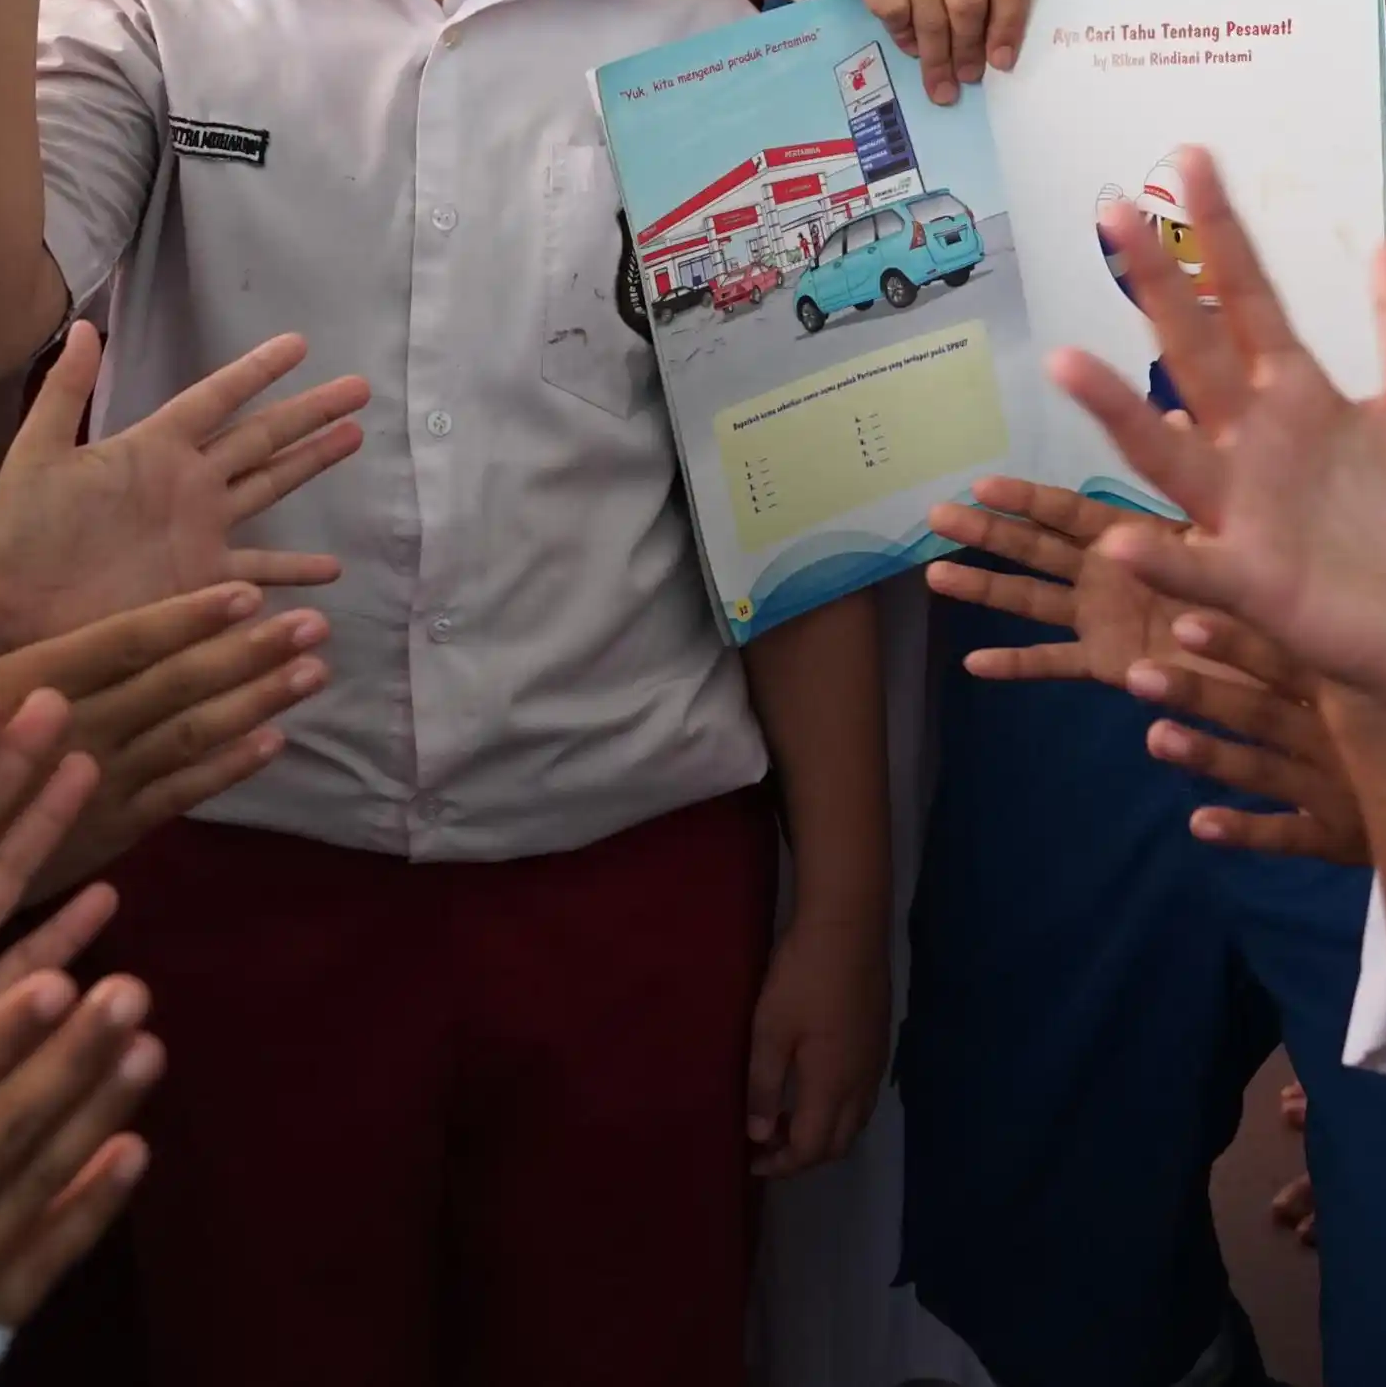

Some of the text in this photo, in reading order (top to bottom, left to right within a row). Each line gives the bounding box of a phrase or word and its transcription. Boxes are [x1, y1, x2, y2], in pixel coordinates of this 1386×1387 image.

[1085, 25, 1115, 43] Cari
[1121, 23, 1155, 41] Tahu
[1162, 21, 1220, 42] Tentang
[1226, 19, 1292, 38] Pesawat!
[652, 78, 674, 92] kita
[677, 59, 724, 85] mengenal
[728, 47, 762, 72] produk
[1150, 51, 1200, 67] Rindiani
[1205, 50, 1253, 65] Pratami
